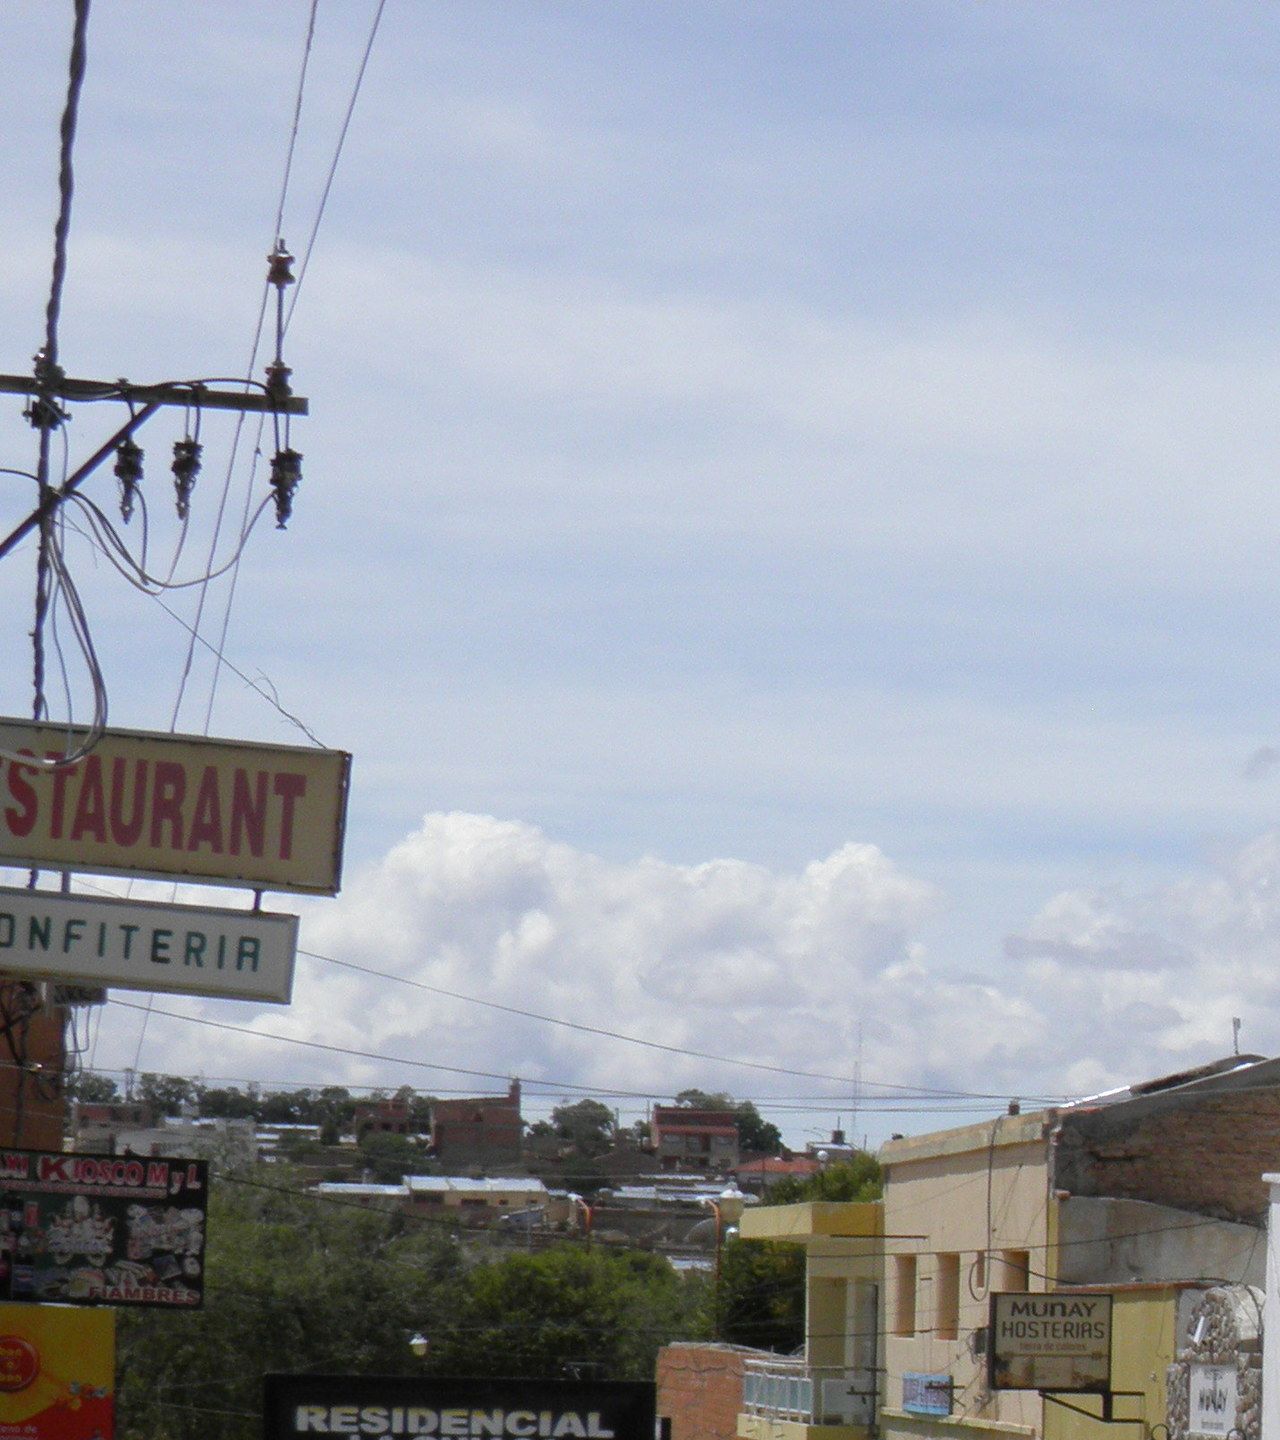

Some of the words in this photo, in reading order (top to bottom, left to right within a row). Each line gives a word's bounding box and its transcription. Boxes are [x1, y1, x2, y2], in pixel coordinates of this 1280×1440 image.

[0, 750, 307, 861] STAURANT
[38, 1155, 144, 1186] KIOSCO
[147, 1162, 169, 1188] M
[88, 1285, 201, 1305] FIAMBRES
[1001, 1320, 1105, 1339] HOSTERIAS
[295, 1405, 614, 1438] RESIDENCIAL
